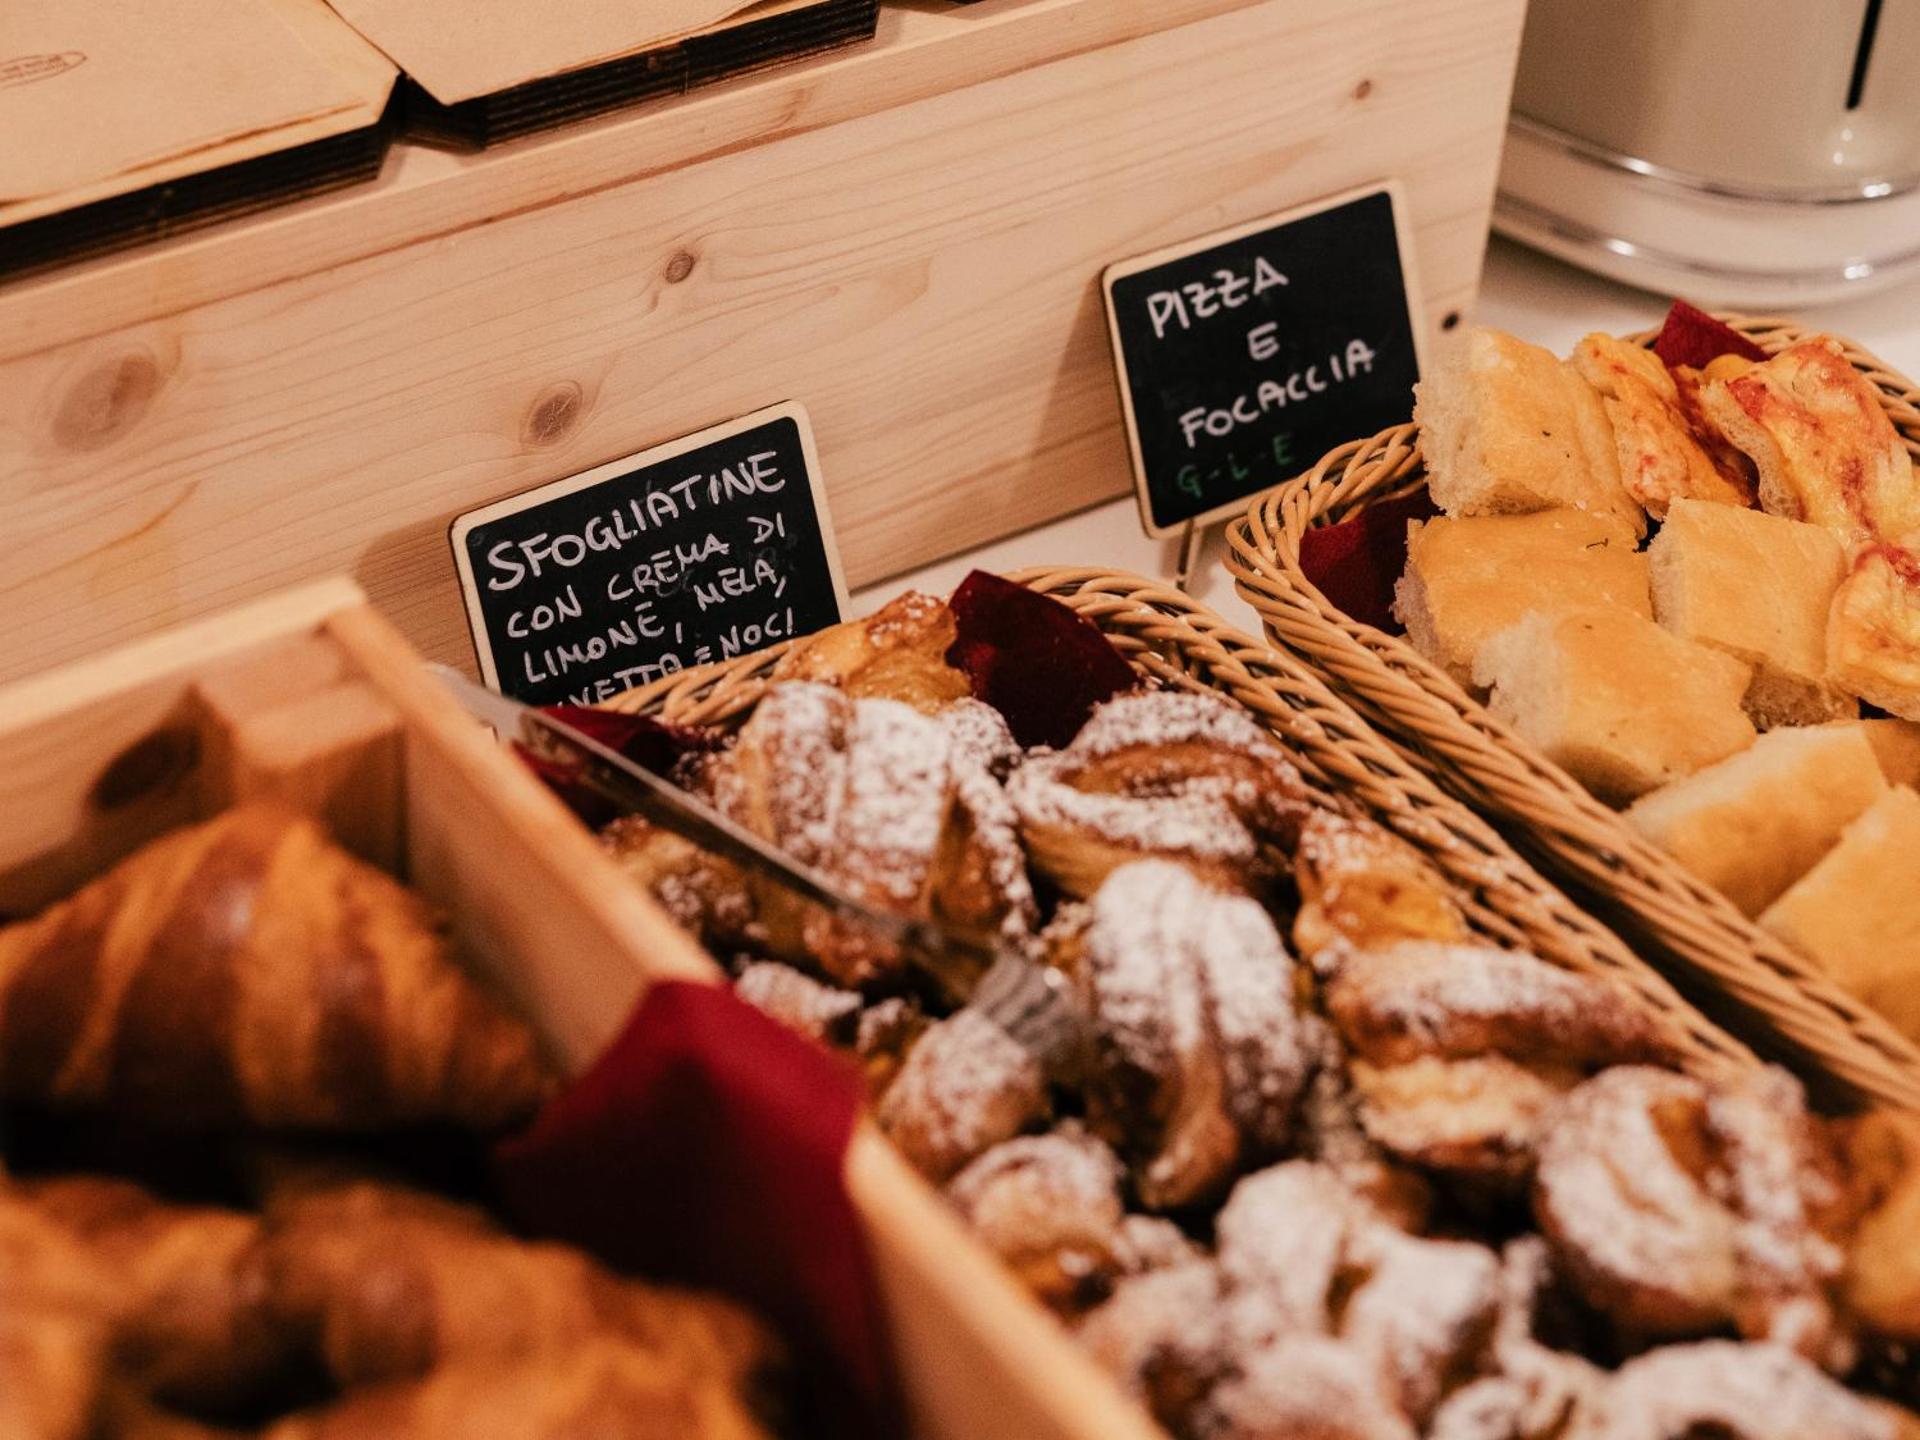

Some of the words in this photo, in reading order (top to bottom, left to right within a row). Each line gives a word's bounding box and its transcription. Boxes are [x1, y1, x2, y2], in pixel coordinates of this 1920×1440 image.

[1147, 256, 1289, 339] PIZZA
[1247, 322, 1280, 360] E
[1179, 339, 1375, 448] FOCACCIA
[487, 451, 786, 591] SFOGLIATINE
[507, 585, 582, 638] CON
[607, 533, 729, 601] CREMA
[747, 512, 785, 544] DI
[693, 558, 786, 611] MELA,
[557, 653, 683, 708] VETTA
[720, 607, 794, 660] NOCI
